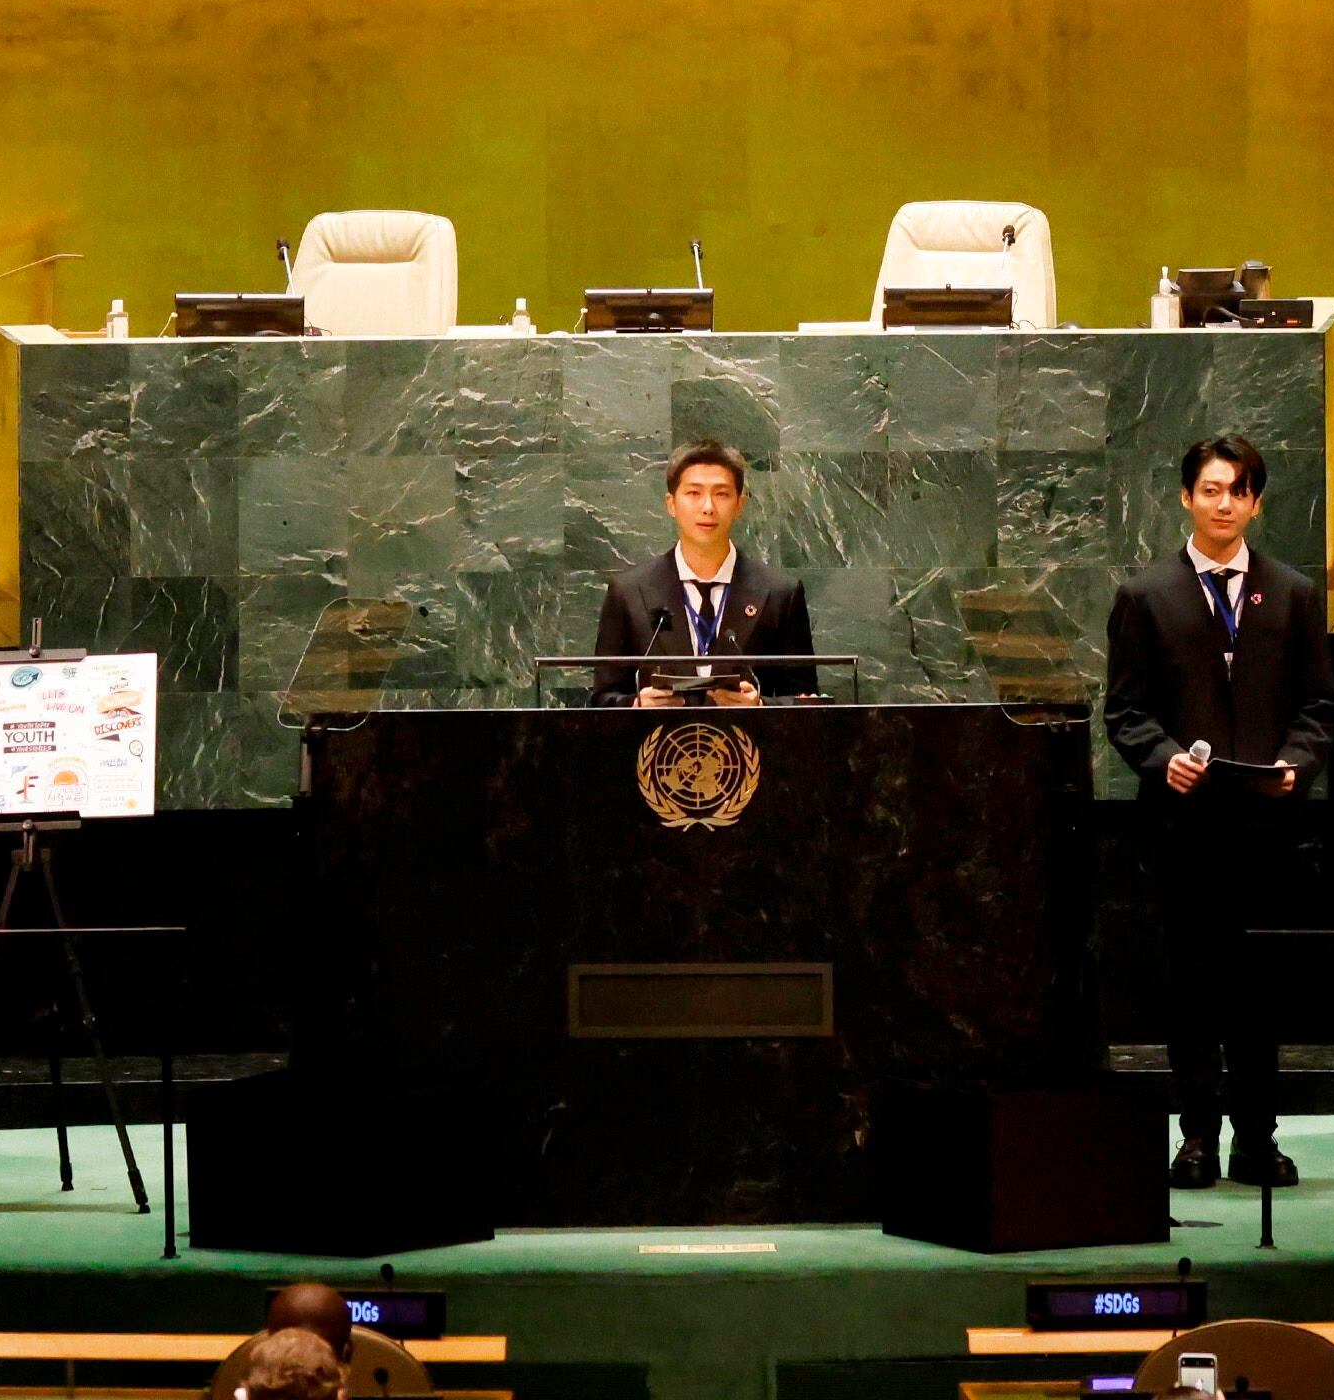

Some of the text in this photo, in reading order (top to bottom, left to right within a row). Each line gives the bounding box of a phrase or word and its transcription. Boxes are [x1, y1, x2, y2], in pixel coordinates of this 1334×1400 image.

[4, 730, 55, 744] YOUTH
[346, 1301, 380, 1323] DGs
[1094, 1292, 1140, 1314] #SDGs
